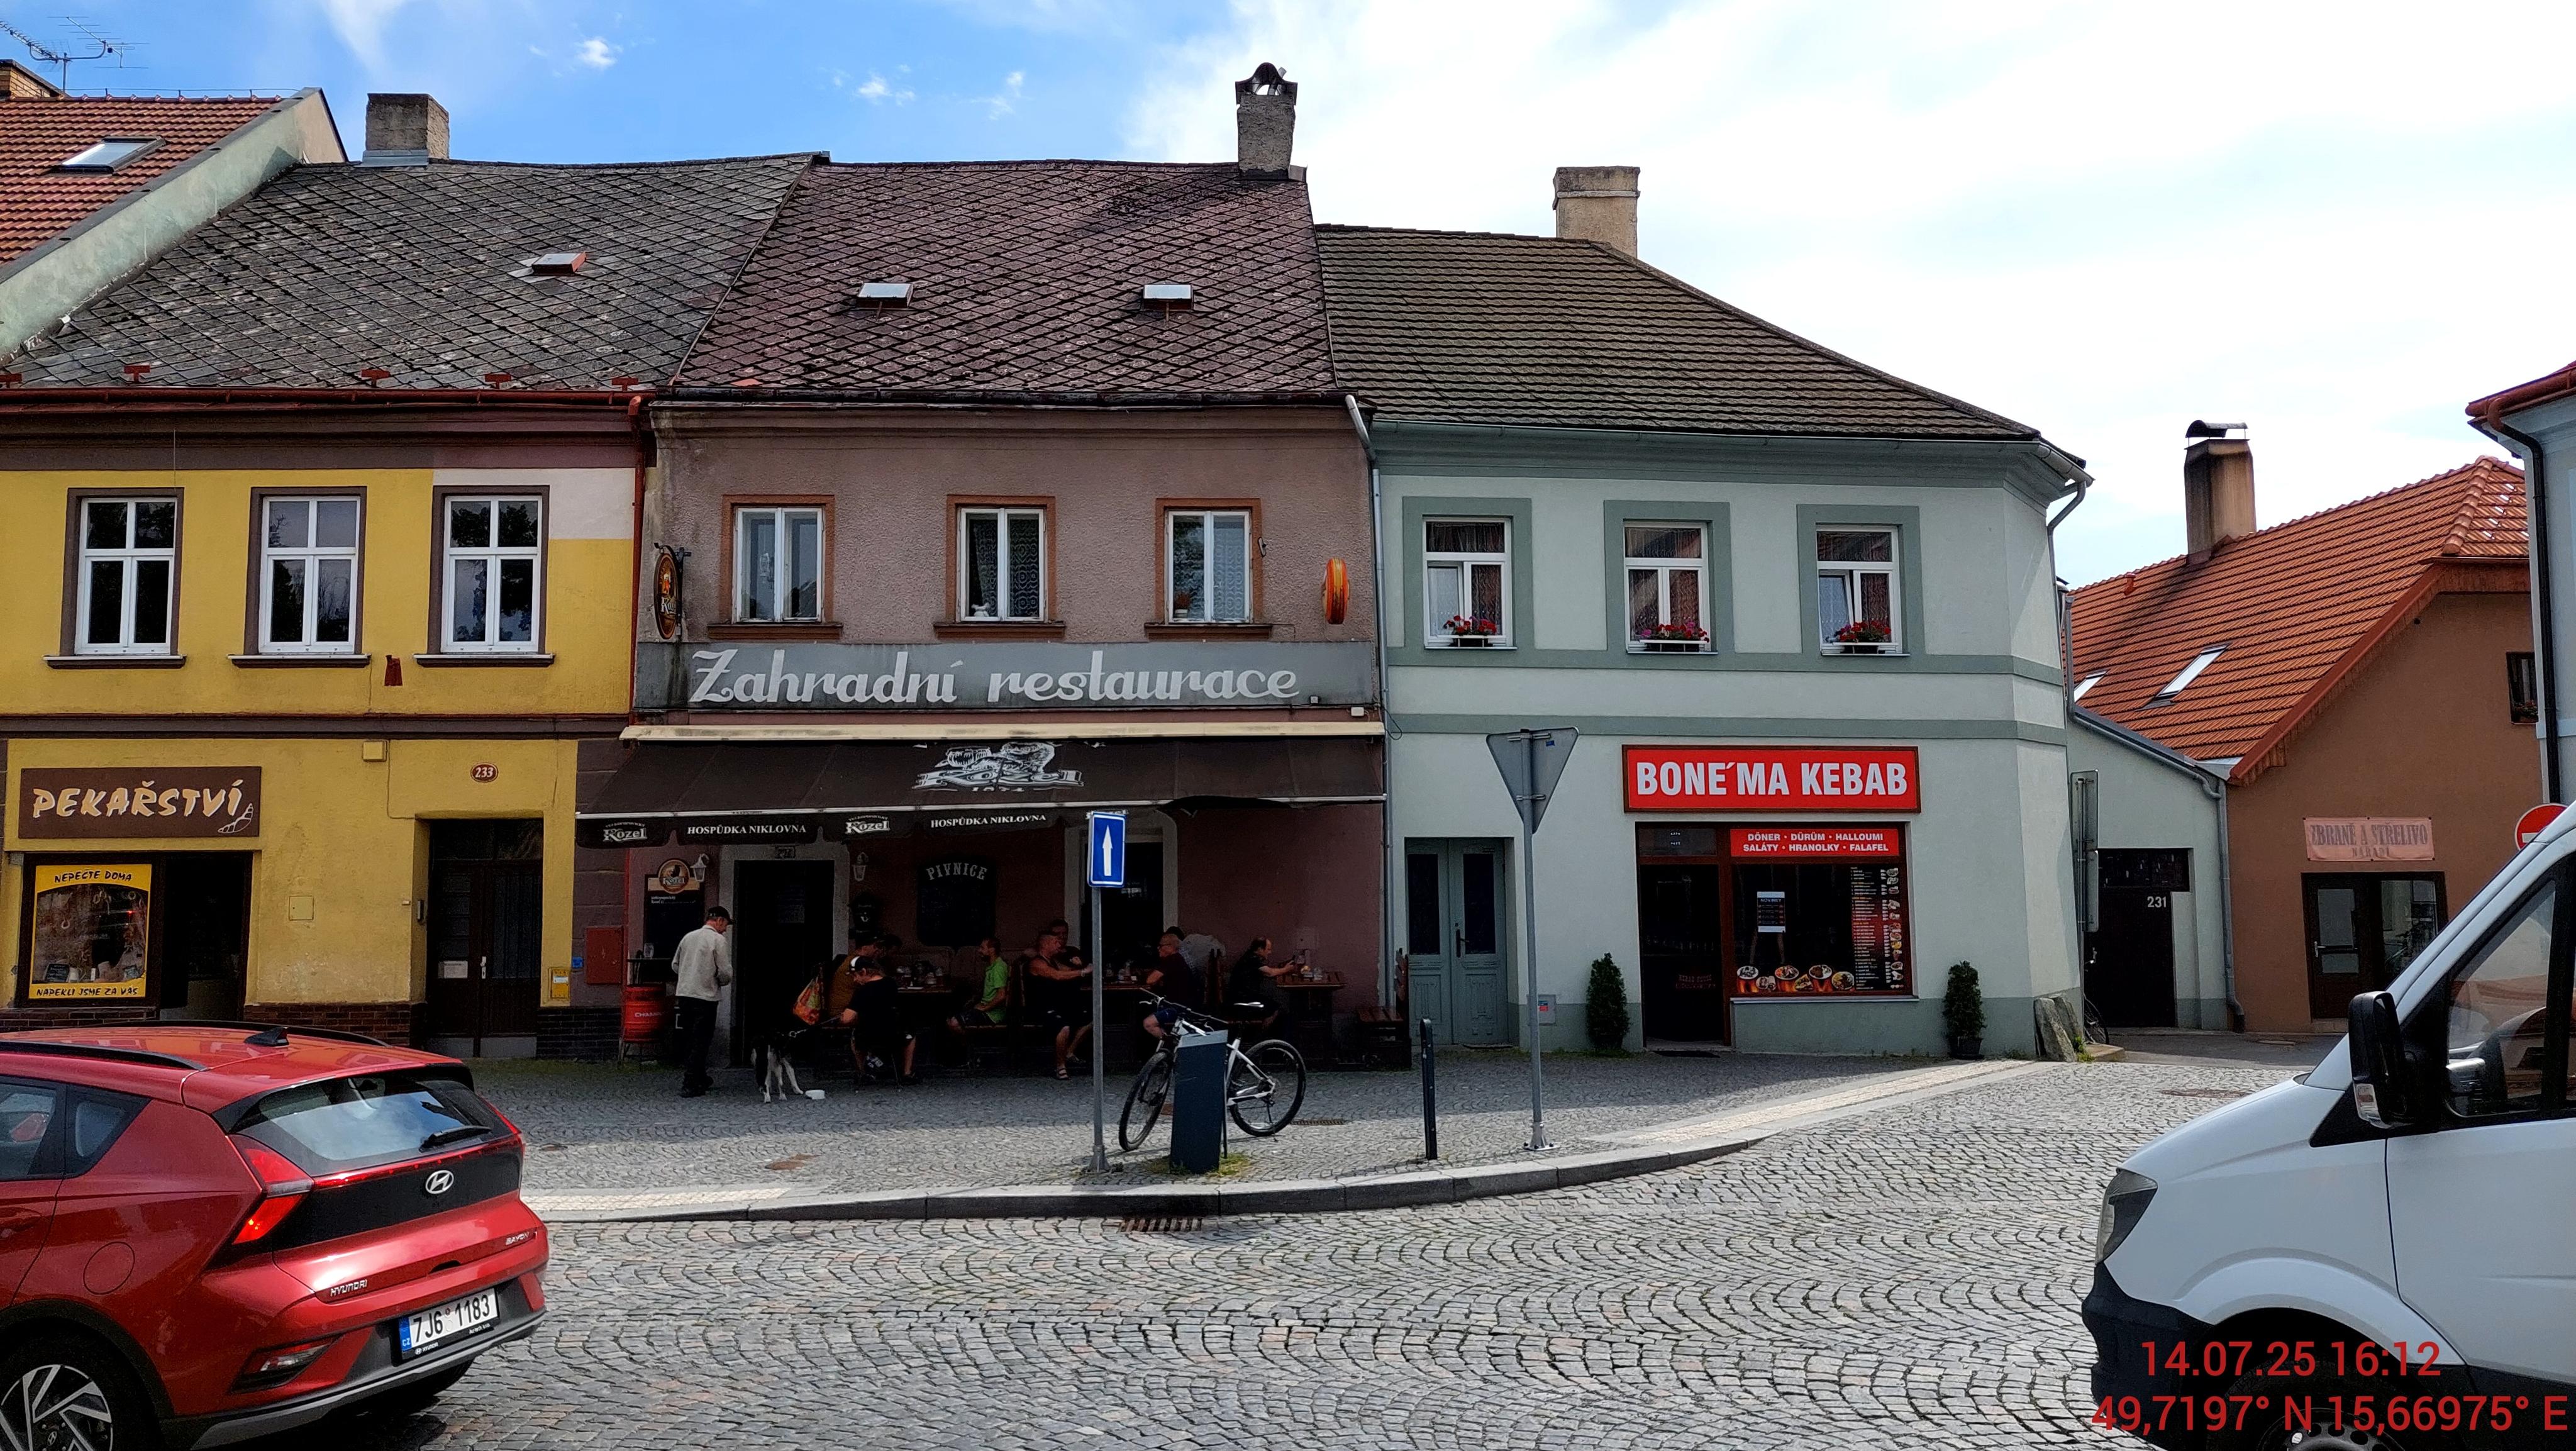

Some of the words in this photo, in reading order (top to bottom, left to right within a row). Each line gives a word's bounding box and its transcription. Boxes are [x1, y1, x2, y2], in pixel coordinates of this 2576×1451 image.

[689, 648, 963, 704] Zahradní
[987, 650, 1300, 702] restaurace
[475, 767, 494, 778] 233
[1801, 762, 1908, 796] KEBAB
[33, 779, 243, 818] PEKAŘSTVÍ
[845, 821, 891, 835] Kozel
[931, 816, 989, 828] HOSPŮDKA
[989, 814, 1046, 825] NIKLOVNA
[602, 828, 648, 842] Kozel
[687, 824, 747, 834] HOSPŮDKA
[748, 825, 806, 833] NIKLOVNA
[2360, 825, 2368, 845] A
[2370, 822, 2428, 845] STŘELIVO
[1747, 832, 1781, 842] DÖNER
[1790, 832, 1825, 842] DÜRÜM
[1835, 833, 1884, 842] HALLOUMI
[1743, 842, 1779, 852] SALÁTY
[1789, 843, 1840, 852] HRANOLKY
[1850, 843, 1889, 852] FALAFEL
[54, 869, 101, 882] NEPEČTE
[104, 870, 133, 881] DOMA
[926, 862, 988, 881] PIVNICE
[2146, 896, 2167, 908] 231
[36, 988, 75, 996] NAPEKLI
[506, 1231, 530, 1245] BAYON
[330, 1279, 368, 1296] HYUNDAI
[411, 1310, 443, 1343] 7J6
[455, 1294, 491, 1327] 1183
[402, 1337, 411, 1347] CZ
